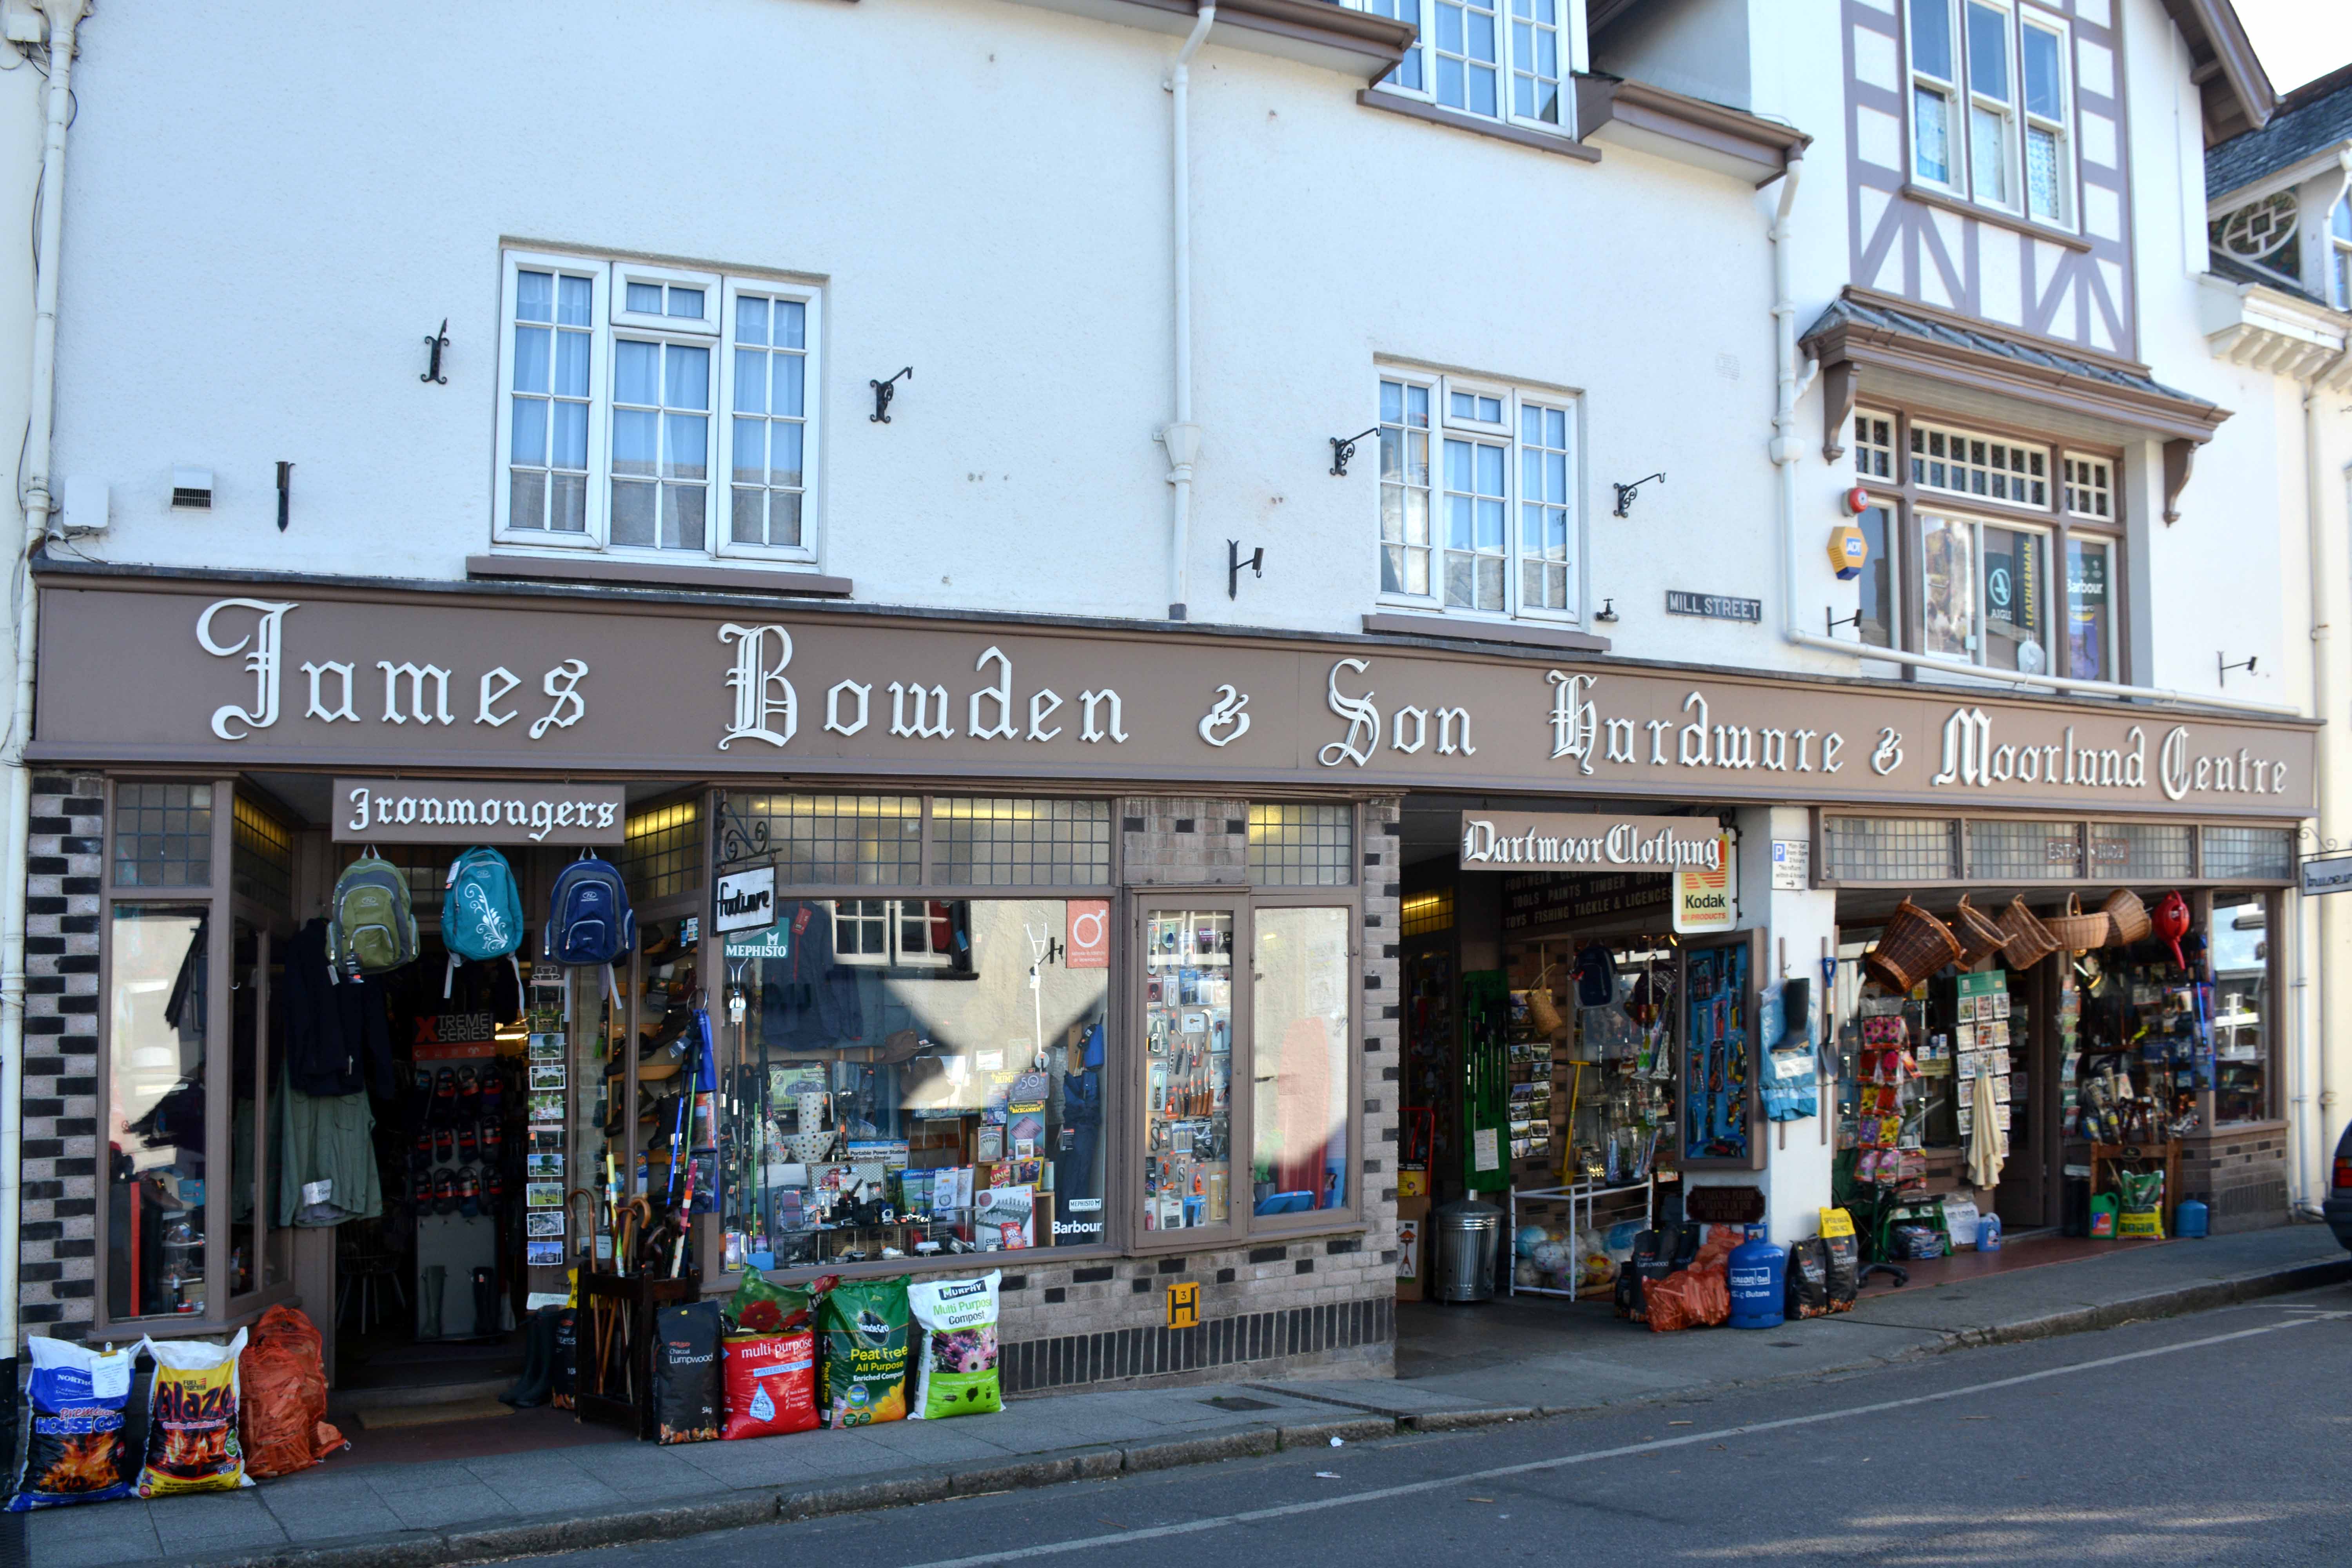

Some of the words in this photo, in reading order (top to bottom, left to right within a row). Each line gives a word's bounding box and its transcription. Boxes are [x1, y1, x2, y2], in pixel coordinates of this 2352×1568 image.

[2024, 542, 2034, 626] LEATHERMAN
[1670, 593, 1701, 613] MILL
[1704, 598, 1759, 618] STREET
[1991, 608, 2012, 620] AIGLE
[196, 597, 588, 739] James
[718, 622, 1129, 750] Bowden
[1198, 684, 1250, 746] &
[1318, 659, 1477, 767] Son
[1546, 669, 1844, 775] Hardware
[1871, 727, 1903, 775] &
[1932, 708, 2146, 787] Moorland
[2160, 725, 2288, 800] Centre
[349, 788, 618, 841] Ironmongers
[1463, 820, 1604, 863] Dartmoor
[1605, 824, 1719, 872] Clothing
[1775, 846, 1783, 860] P
[1505, 871, 1552, 891] FOOTWEAR
[1512, 892, 1539, 909] TOOLS
[1548, 884, 1581, 903] PAINTS
[1590, 875, 1626, 894] TIMBER
[1635, 871, 1667, 885] GIFTS
[1505, 914, 1527, 929] TOYS
[1534, 906, 1570, 924] FISHING
[1574, 898, 1609, 916] TACKLE
[1625, 886, 1673, 907] LICENCES
[1686, 894, 1725, 909] Kodak
[726, 945, 786, 957] MEPHISTO
[439, 1027, 489, 1042] SERIES
[1022, 1075, 1039, 1089] 50
[1006, 1229, 1018, 1238] Pit
[1052, 1221, 1102, 1234] Barbour
[943, 1283, 982, 1299] MURPHY
[1181, 1291, 1186, 1300] 3
[933, 1303, 956, 1316] Multi
[959, 1298, 993, 1312] Purpose
[1172, 1288, 1195, 1324] H
[949, 1310, 985, 1325] Compost
[741, 1343, 771, 1358] multi
[774, 1338, 812, 1358] purpose
[851, 1348, 880, 1361] Peat
[883, 1345, 908, 1359] Free
[670, 1353, 713, 1365] Lumpwood
[855, 1363, 868, 1372] All
[871, 1361, 904, 1372] Purpose
[756, 1365, 792, 1375] WATERLOCK
[853, 1374, 880, 1382] Enriched
[881, 1370, 904, 1381] Compost
[155, 1381, 236, 1421] Blaze
[60, 1405, 115, 1421] Premium
[36, 1417, 93, 1434] HOUSE
[94, 1412, 125, 1432] COA
